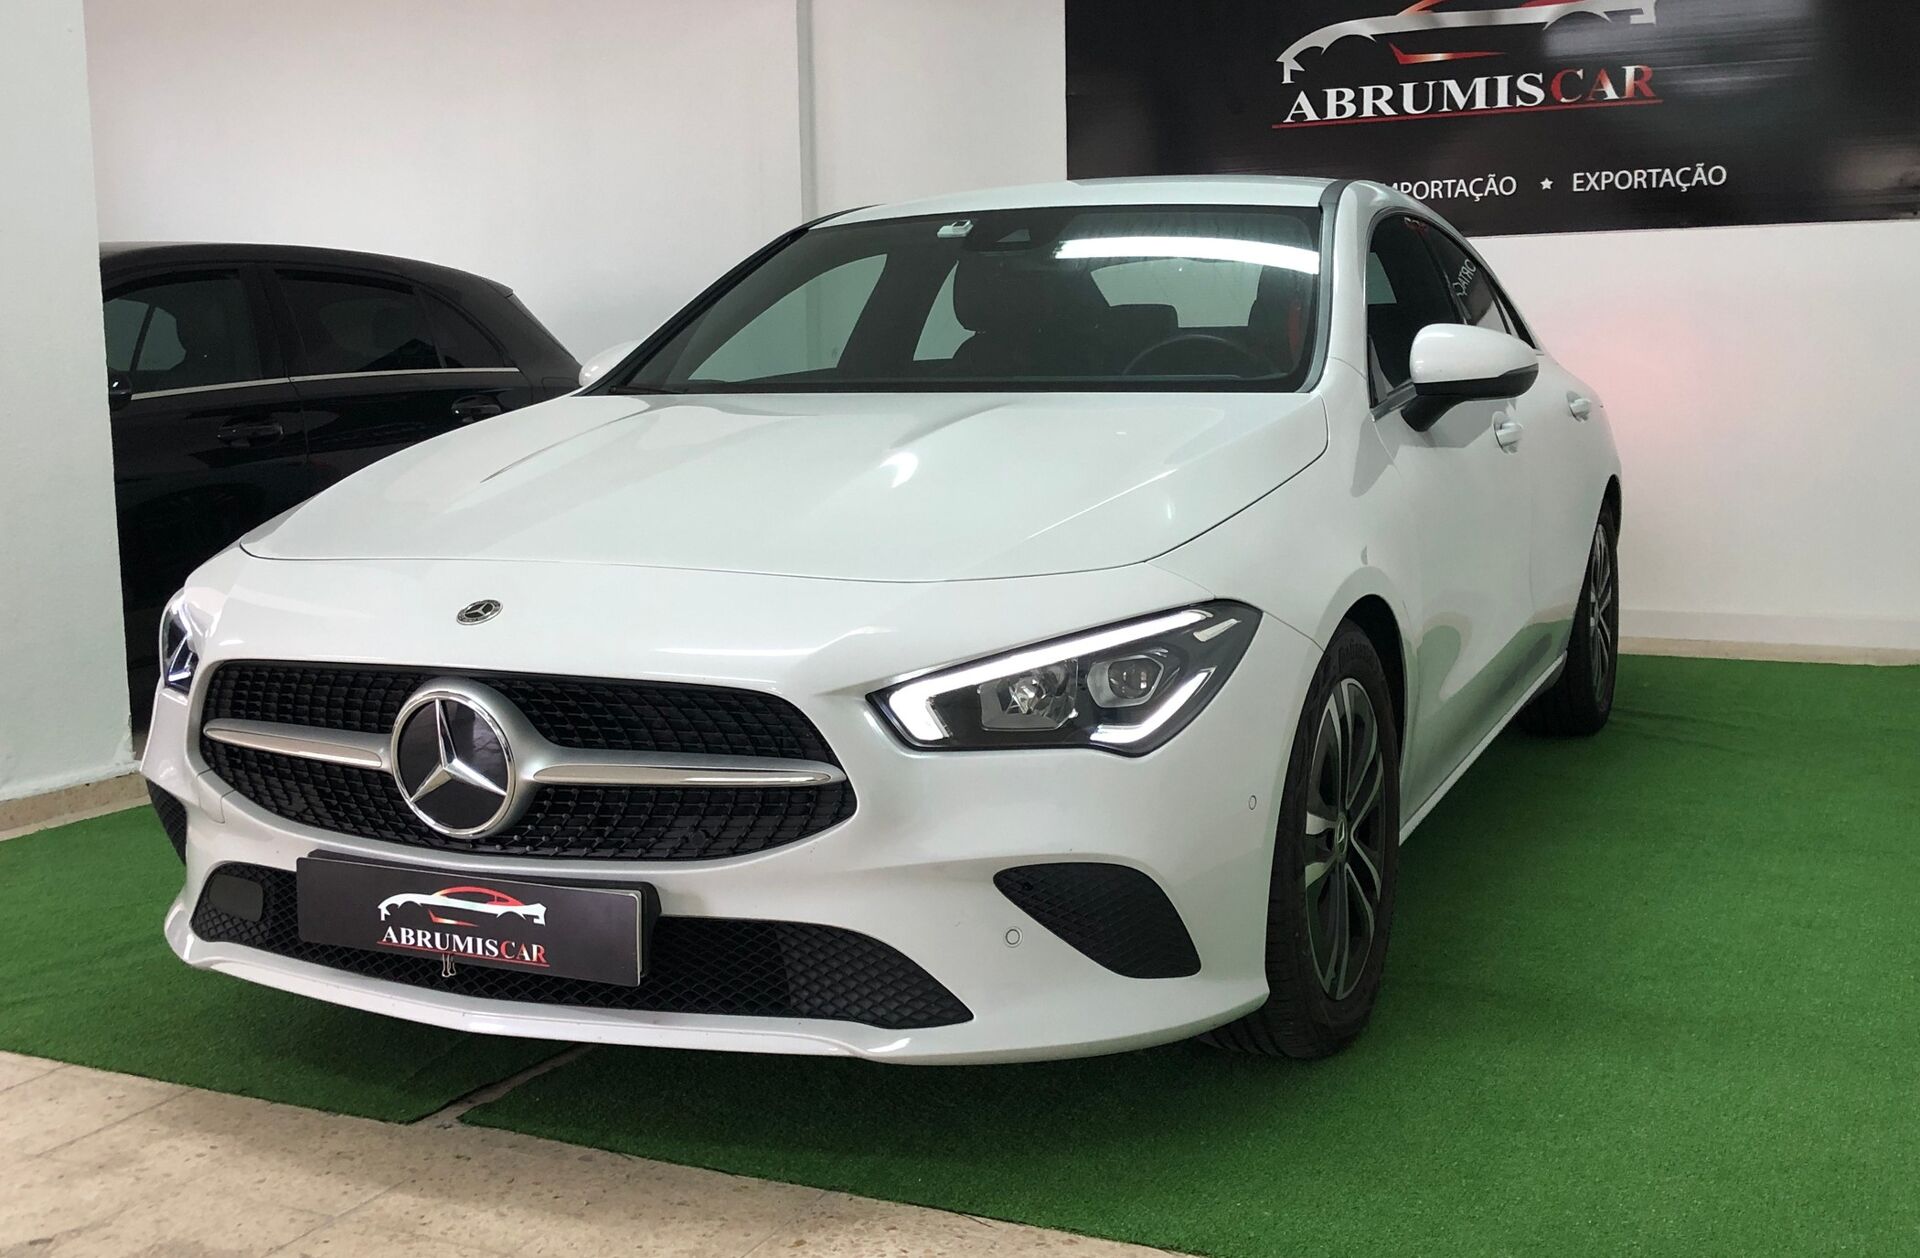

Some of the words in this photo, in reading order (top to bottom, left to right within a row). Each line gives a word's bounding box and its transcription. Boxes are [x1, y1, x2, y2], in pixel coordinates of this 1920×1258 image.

[1282, 64, 1656, 123] ABRUMISCAR
[1391, 172, 1517, 202] PORTAÇÃO
[1572, 163, 1727, 194] EXPORTAÇÃO
[382, 926, 547, 962] ABRUMISCAR
